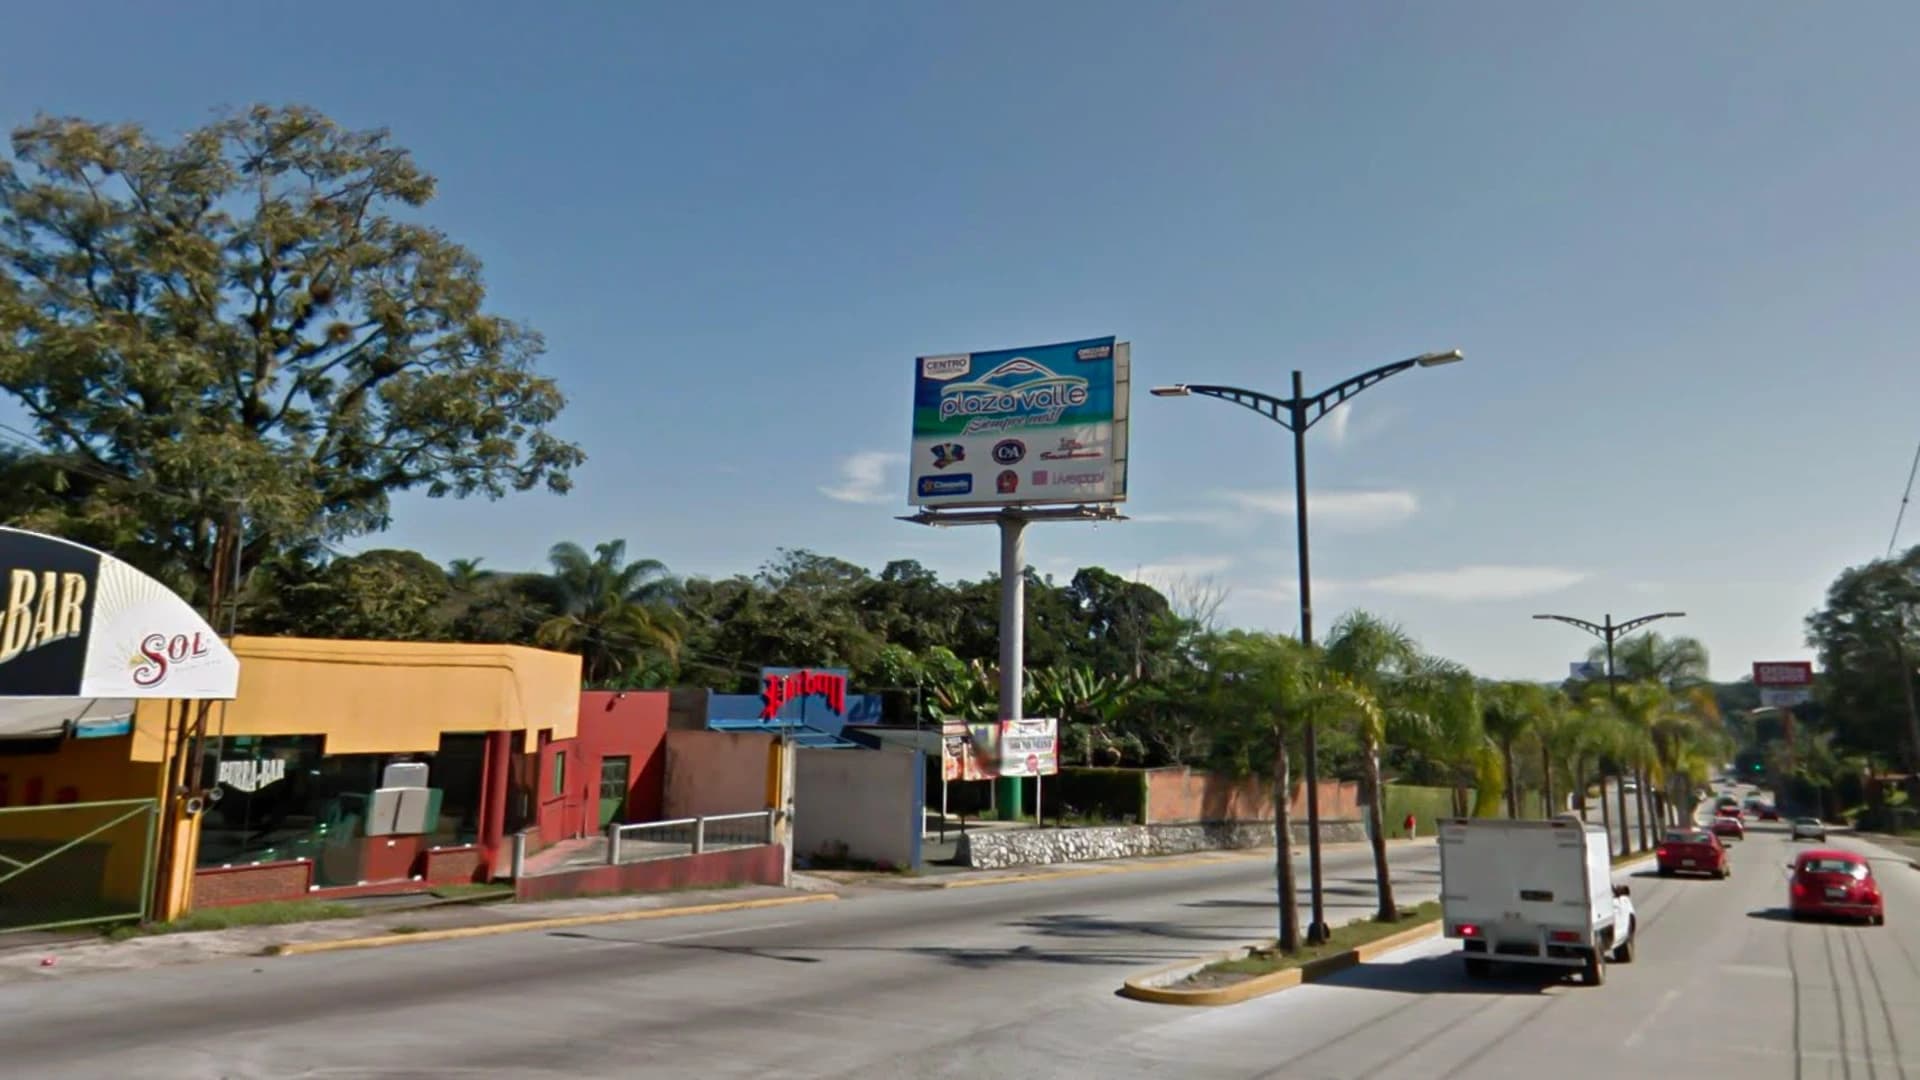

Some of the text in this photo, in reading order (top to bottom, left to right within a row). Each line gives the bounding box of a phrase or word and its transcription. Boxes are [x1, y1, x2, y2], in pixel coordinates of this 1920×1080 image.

[926, 358, 968, 370] CENTRO
[940, 383, 1088, 421] plaza valle
